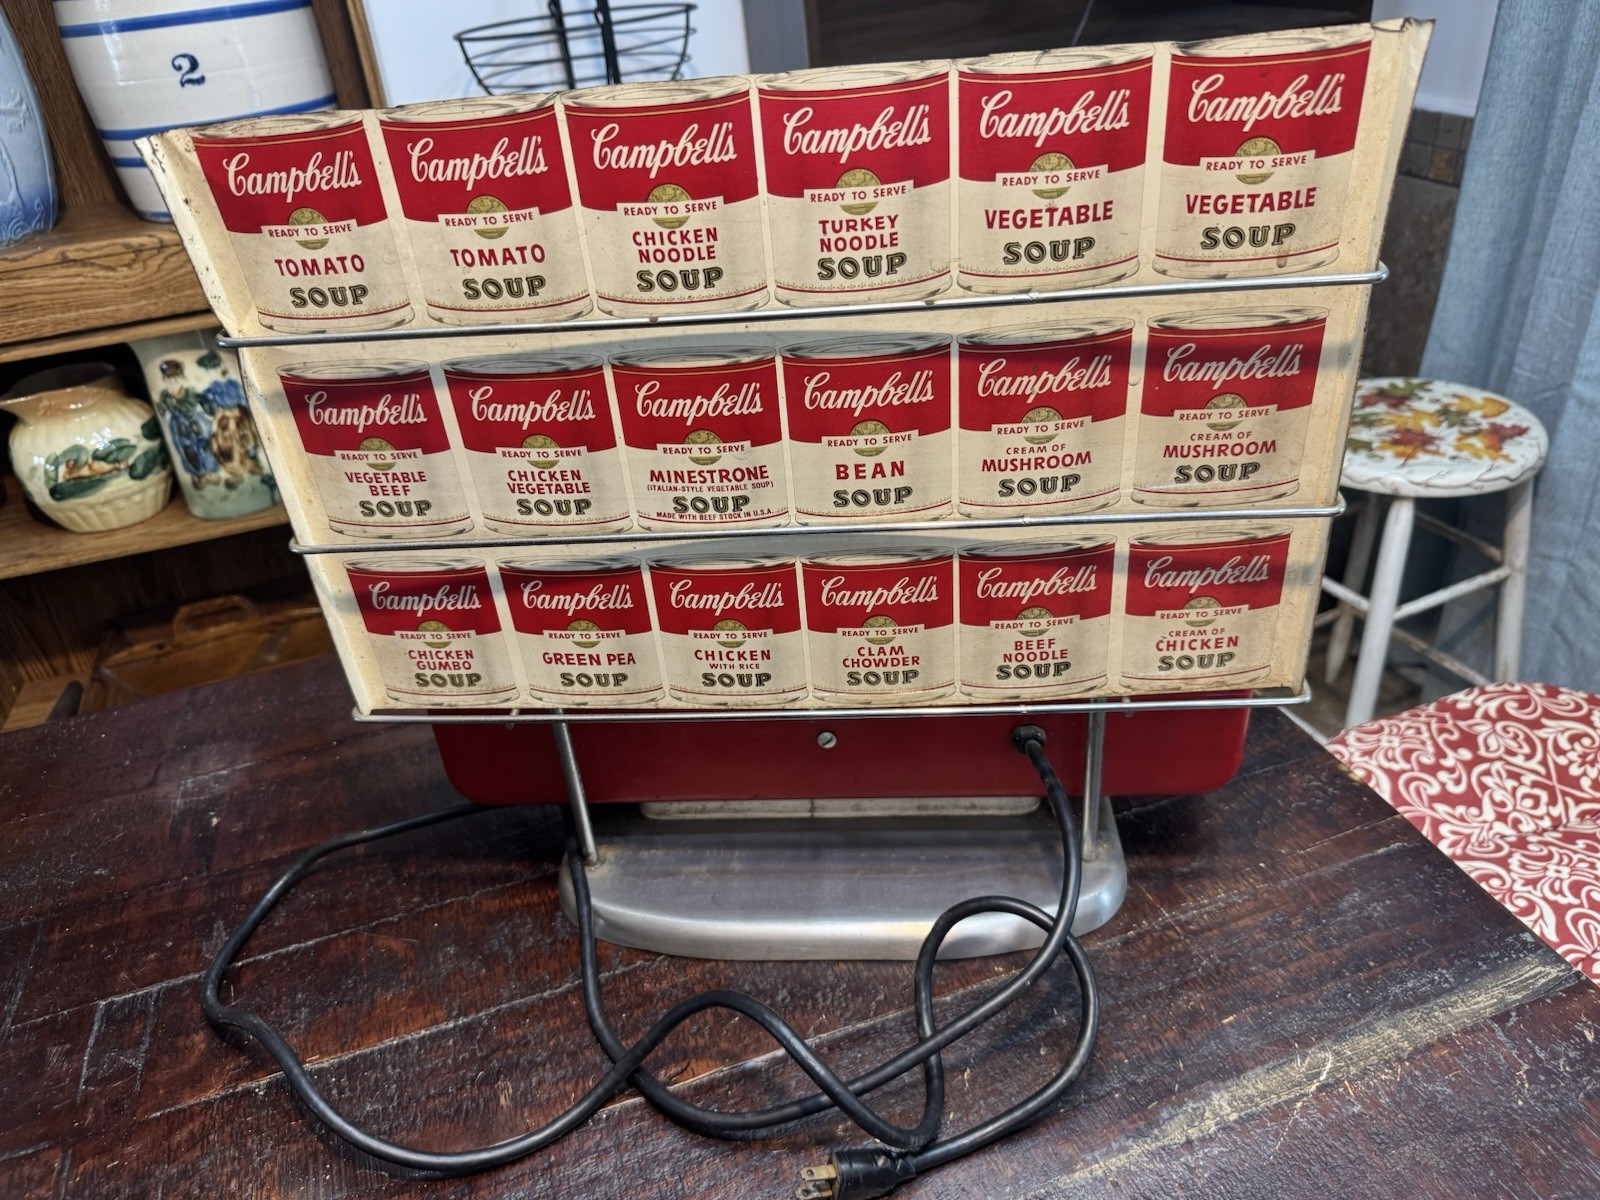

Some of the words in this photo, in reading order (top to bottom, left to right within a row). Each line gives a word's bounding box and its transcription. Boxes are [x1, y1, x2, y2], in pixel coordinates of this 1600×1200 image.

[171, 53, 206, 88] 2
[1188, 73, 1345, 132] Campbell's
[979, 89, 1130, 148] Campbell's
[783, 104, 931, 164] Campbell's
[591, 122, 737, 179] Campbell's
[407, 135, 549, 191] Campbell's
[1206, 161, 1243, 171] READY
[1249, 160, 1264, 169] TO
[1271, 155, 1307, 167] SERVE
[223, 150, 362, 203] Campbell's
[1002, 176, 1038, 186] READY
[1044, 175, 1059, 184] TO
[1066, 170, 1100, 182] SERVE
[810, 192, 845, 203] READY
[852, 191, 867, 200] TO
[873, 185, 906, 198] SERVE
[1185, 187, 1317, 215] VEGETABLE
[624, 207, 658, 216] READY
[663, 205, 679, 214] TO
[685, 201, 717, 213] SERVE
[984, 200, 1114, 229] VEGETABLE
[445, 217, 478, 227] READY
[483, 216, 497, 225] TO
[503, 212, 534, 223] SERVE
[818, 214, 899, 234] TURKEY
[268, 227, 300, 238] READY
[305, 228, 318, 236] TO
[323, 224, 352, 235] SERVE
[632, 227, 718, 246] CHICKEN
[1200, 223, 1296, 250] SOUP
[819, 232, 899, 252] NOODLE
[1003, 236, 1096, 265] SOUP
[450, 244, 545, 267] TOMATO
[638, 245, 716, 263] NOODLE
[274, 254, 365, 277] TOMATO
[817, 252, 907, 280] SOUP
[462, 275, 546, 300] SOUP
[636, 267, 723, 292] SOUP
[290, 284, 369, 308] SOUP
[1163, 343, 1303, 390] Campbell's
[977, 355, 1112, 404] Campbell's
[804, 370, 935, 417] Campbell's
[304, 391, 428, 433] Campbell's
[469, 386, 596, 430] Campbell's
[635, 380, 764, 426] Campbell's
[1179, 413, 1213, 421] READY
[1238, 408, 1270, 418] SERVE
[997, 426, 1029, 435] READY
[1054, 420, 1085, 430] SERVE
[1190, 432, 1232, 441] CREAM
[883, 434, 912, 444] SERVE
[391, 452, 418, 460] SERVE
[663, 447, 693, 455] READY
[716, 445, 745, 453] SERVE
[1006, 446, 1047, 455] CREAM
[1163, 440, 1276, 458] MUSHROOM
[835, 460, 905, 480] BEAN
[982, 451, 1092, 472] MUSHROOM
[344, 471, 427, 484] VEGETABLE
[508, 469, 582, 482] CHICKEN
[650, 465, 769, 484] MINESTRONE
[1174, 462, 1261, 484] SOUP
[369, 485, 411, 496] BEEF
[507, 482, 591, 494] VEGETABLE
[647, 484, 704, 492] (ITALIAN-STYLE
[707, 483, 748, 492] VEGETABLE
[752, 481, 774, 489] SOUP)
[998, 473, 1081, 498] SOUP
[672, 495, 750, 513] SOUP
[833, 486, 913, 508] SOUP
[359, 500, 432, 517] SOUP
[516, 499, 592, 516] SOUP
[719, 512, 742, 520] STOCK
[753, 508, 774, 518] U.S.A.
[1144, 555, 1271, 594] Campbell's
[977, 565, 1097, 604] Campbell's
[368, 581, 482, 617] Campbell's
[520, 580, 634, 616] Campbell's
[670, 579, 785, 616] Campbell's
[821, 576, 939, 613] Campbell's
[1214, 608, 1242, 616] SERVE
[1046, 618, 1074, 627] SERVE
[857, 646, 905, 656] CLAM
[1014, 638, 1056, 650] BEEF
[1156, 636, 1239, 652] CHICKEN
[408, 650, 474, 660] CHICKEN
[542, 652, 602, 666] GREEN
[607, 653, 636, 666] PEA
[694, 649, 771, 662] CHICKEN
[842, 656, 920, 668] CHOWDER
[1003, 649, 1068, 663] NOODLE
[1158, 652, 1235, 671] SOUP
[416, 661, 472, 671] GUMBO
[996, 662, 1071, 680] SOUP
[414, 673, 482, 688] SOUP
[560, 673, 629, 687] SOUP
[702, 673, 772, 687] SOUP
[847, 670, 919, 686] SOUP
